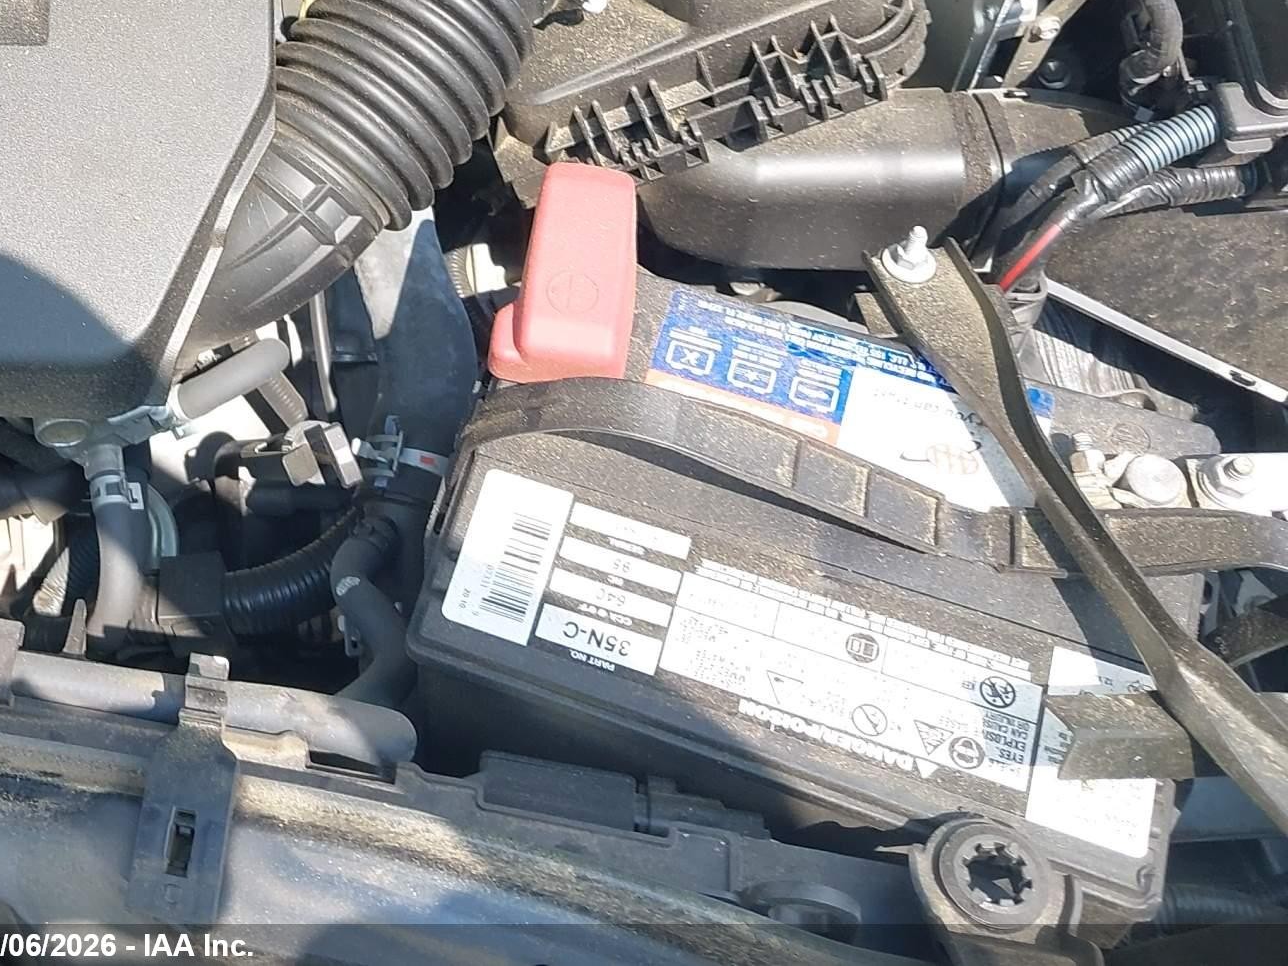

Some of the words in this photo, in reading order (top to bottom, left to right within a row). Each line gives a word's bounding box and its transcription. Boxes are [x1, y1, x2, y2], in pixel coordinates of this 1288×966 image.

[560, 618, 632, 658] 35N-C
[567, 648, 588, 662] NO.
[587, 655, 616, 671] PART
[736, 697, 915, 772] DANGER/POISON
[992, 745, 1025, 764] EYES.
